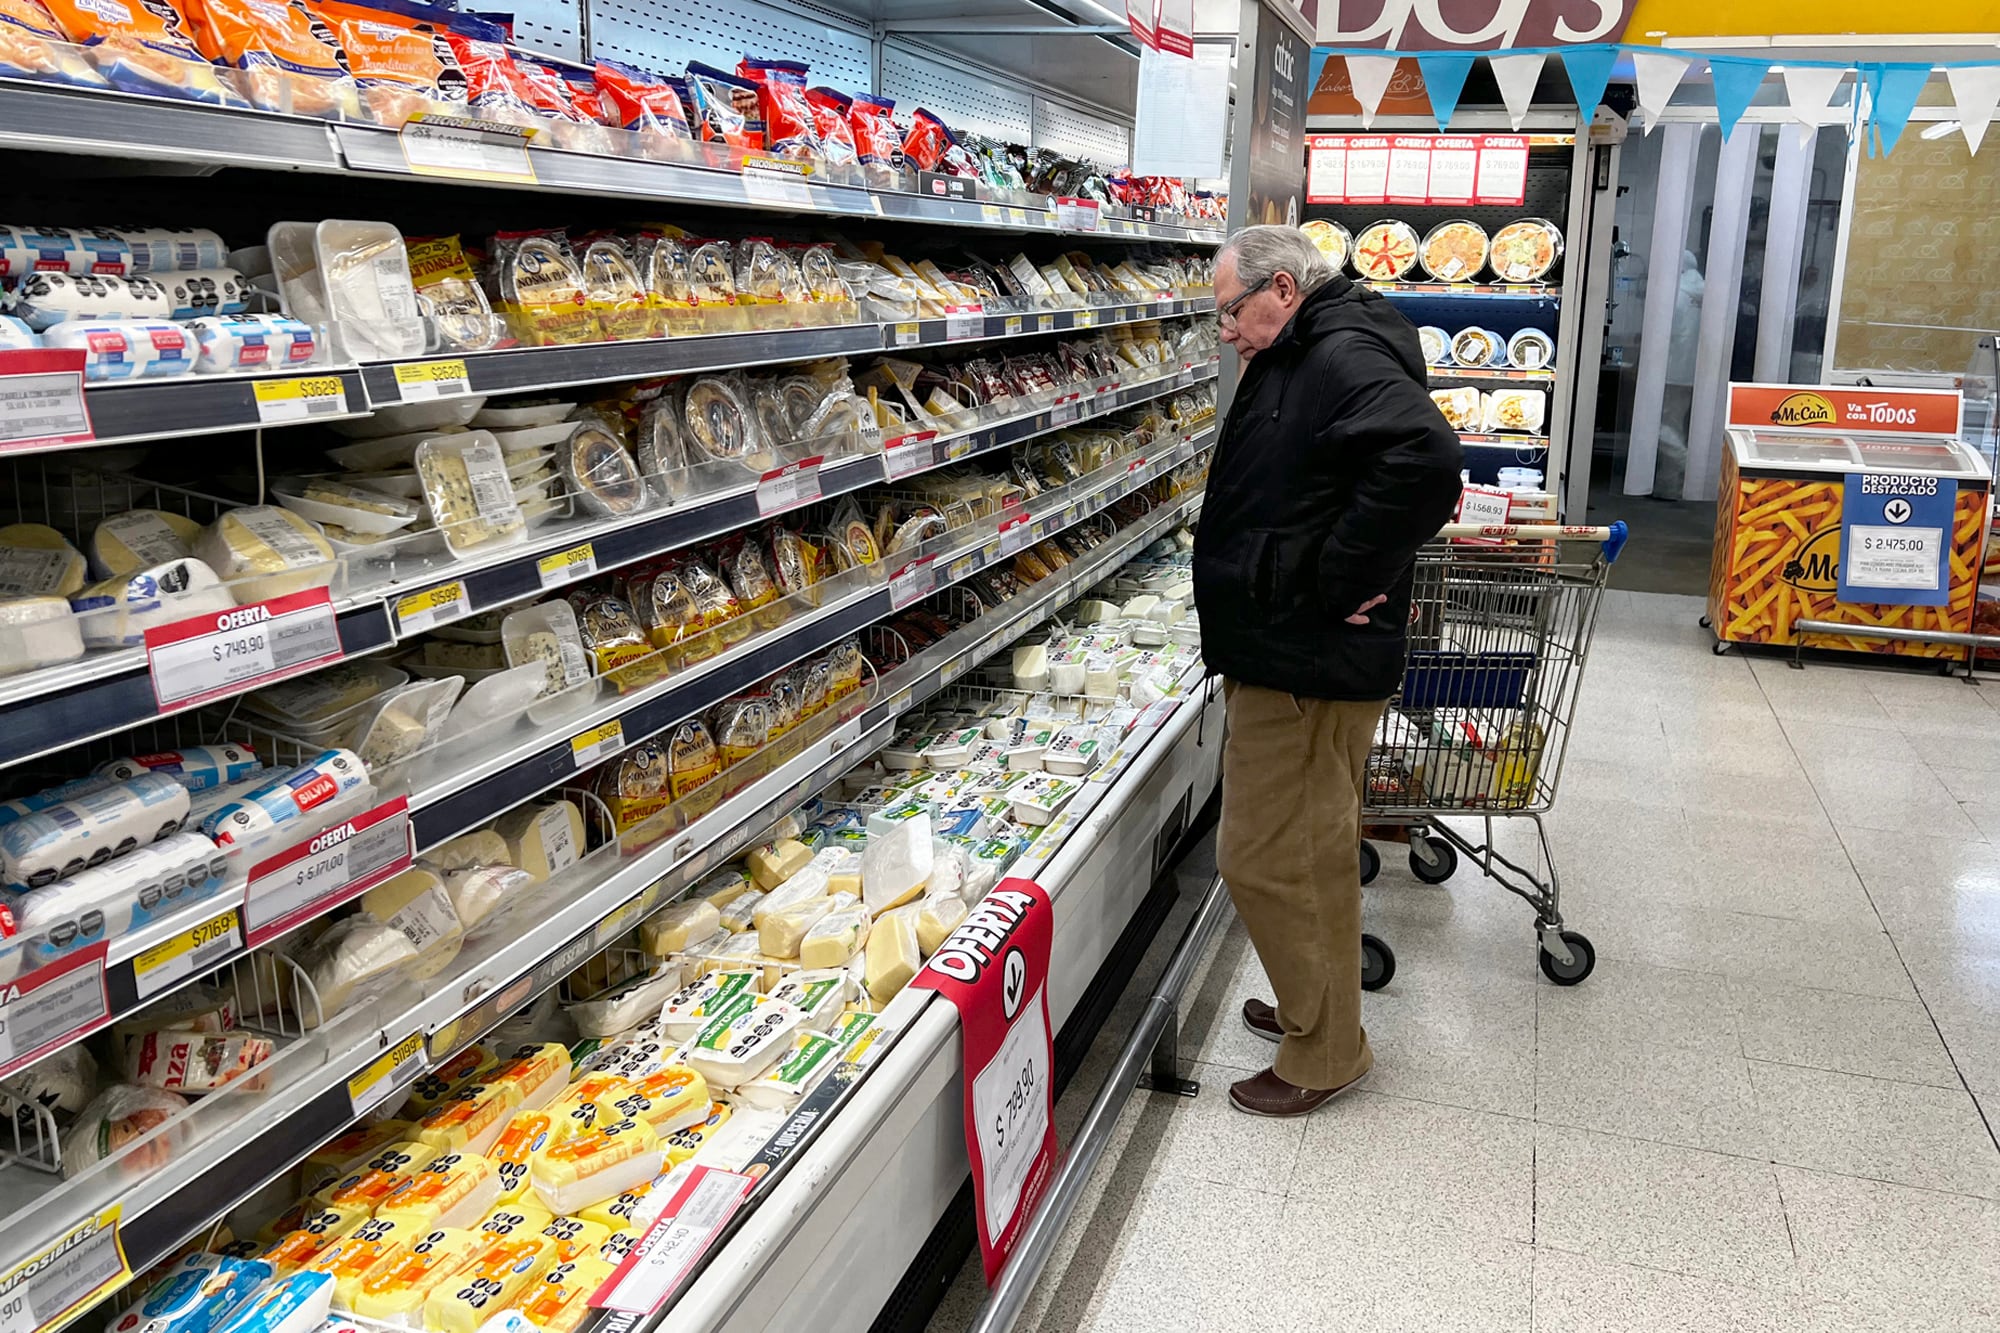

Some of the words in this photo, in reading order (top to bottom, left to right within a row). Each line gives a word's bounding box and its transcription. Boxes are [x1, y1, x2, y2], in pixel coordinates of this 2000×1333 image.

[1350, 138, 1388, 148] OFERTA
[1394, 137, 1431, 149] OFERTA
[1435, 138, 1474, 149] OFERTA
[1484, 137, 1524, 148] OFERTA
[1780, 403, 1829, 422] McCain
[1846, 402, 1863, 413] Va
[1846, 412, 1867, 421] con
[1866, 402, 1917, 425] TODOS
[1861, 474, 1938, 487] PRODUCTO
[1861, 484, 1938, 496] DESTACADO
[1465, 501, 1472, 511] $
[1481, 525, 1518, 537] COTO
[1864, 537, 1872, 551] $
[1876, 538, 1924, 552] 2.475,00
[216, 605, 272, 632] OFERTA
[212, 645, 222, 663] $
[224, 635, 264, 660] 749,90
[298, 779, 334, 805] SILVIA
[309, 823, 357, 856] OFERTA
[296, 870, 304, 887] $
[191, 915, 230, 949] $7169
[927, 889, 1036, 983] OFERTA
[994, 1113, 1005, 1148] $
[1005, 1056, 1035, 1132] 799,90
[775, 1109, 820, 1148] QUESERÍA
[633, 1215, 678, 1257] OFERTA
[651, 1257, 664, 1268] $
